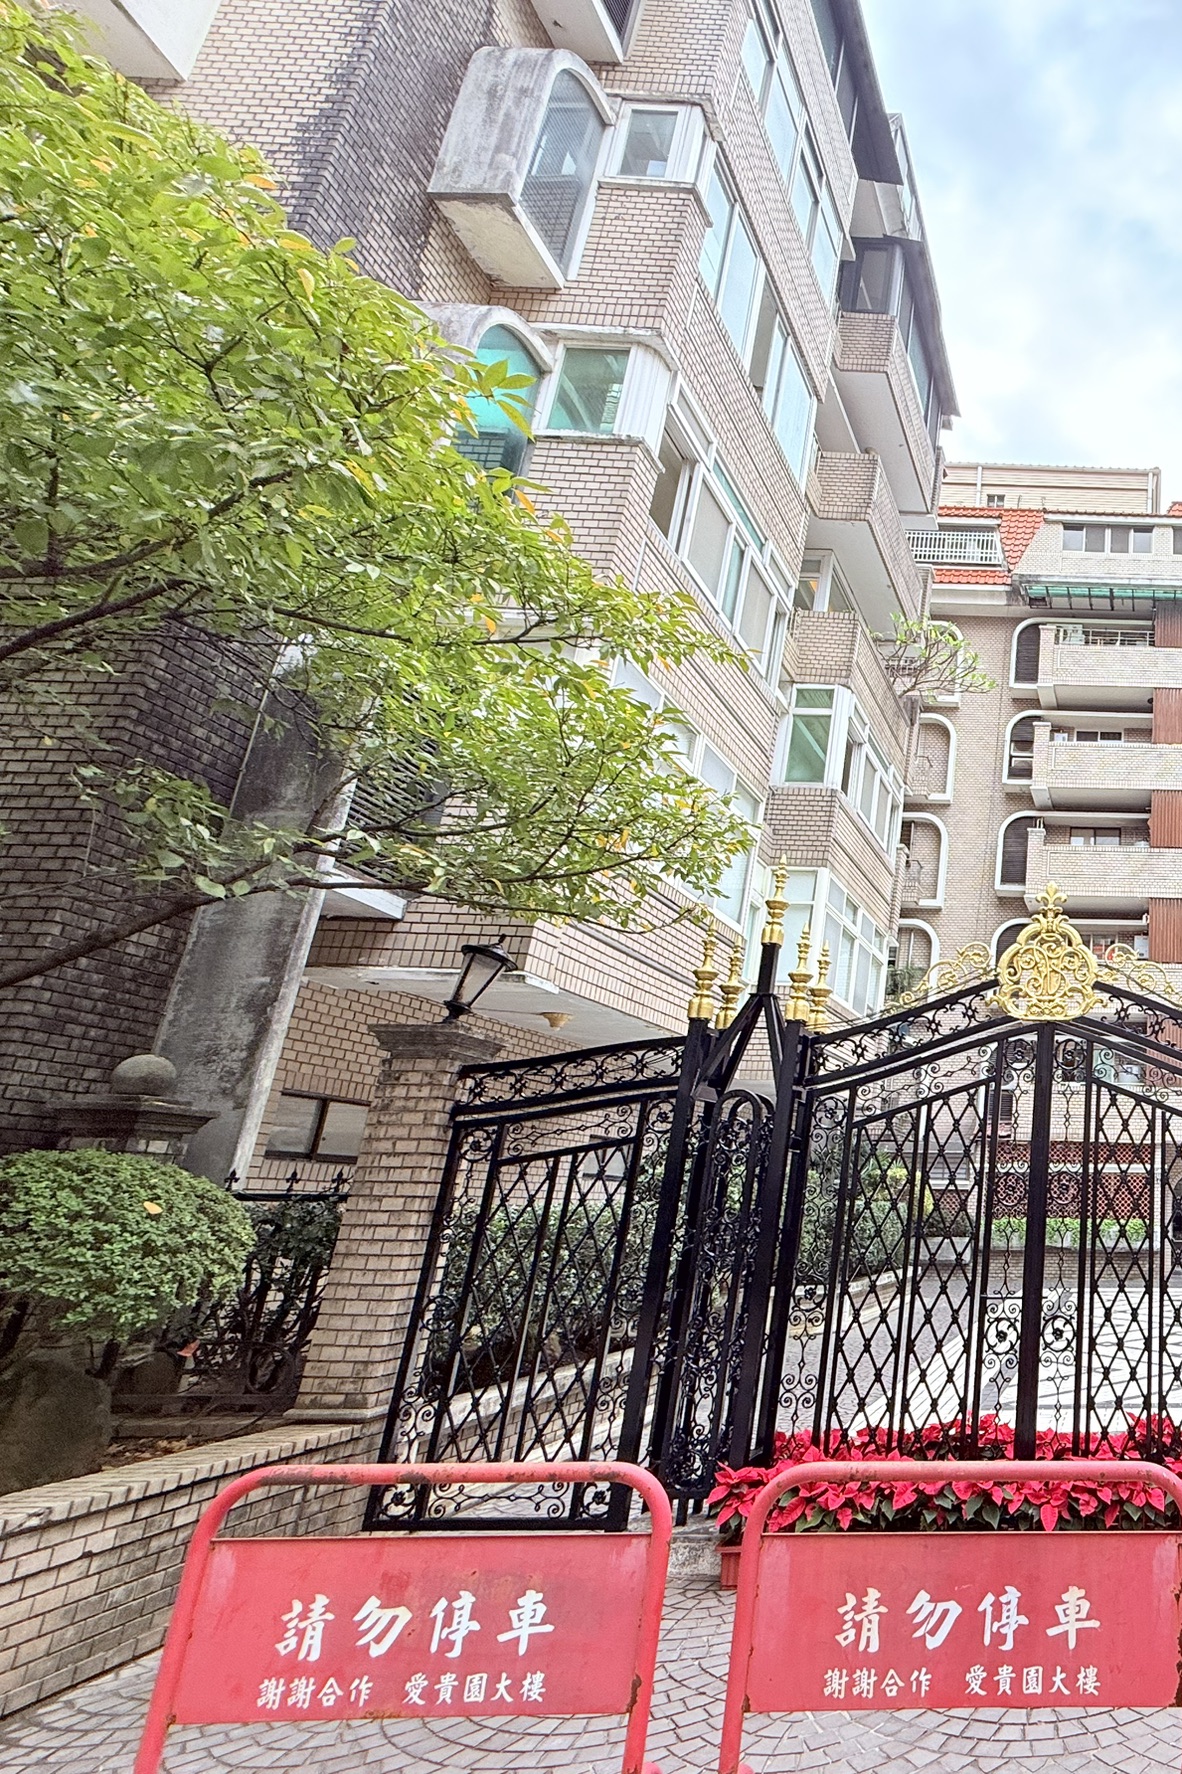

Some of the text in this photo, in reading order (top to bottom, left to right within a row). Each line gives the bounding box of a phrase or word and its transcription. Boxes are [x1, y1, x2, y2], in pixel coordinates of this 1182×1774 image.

[274, 1589, 556, 1662] 請勿停車
[835, 1585, 1102, 1653] 請勿停車
[257, 1670, 546, 1711] 謝謝合作 愛貴園大樓
[823, 1664, 1101, 1699] 謝謝合作 愛貴園大樓
